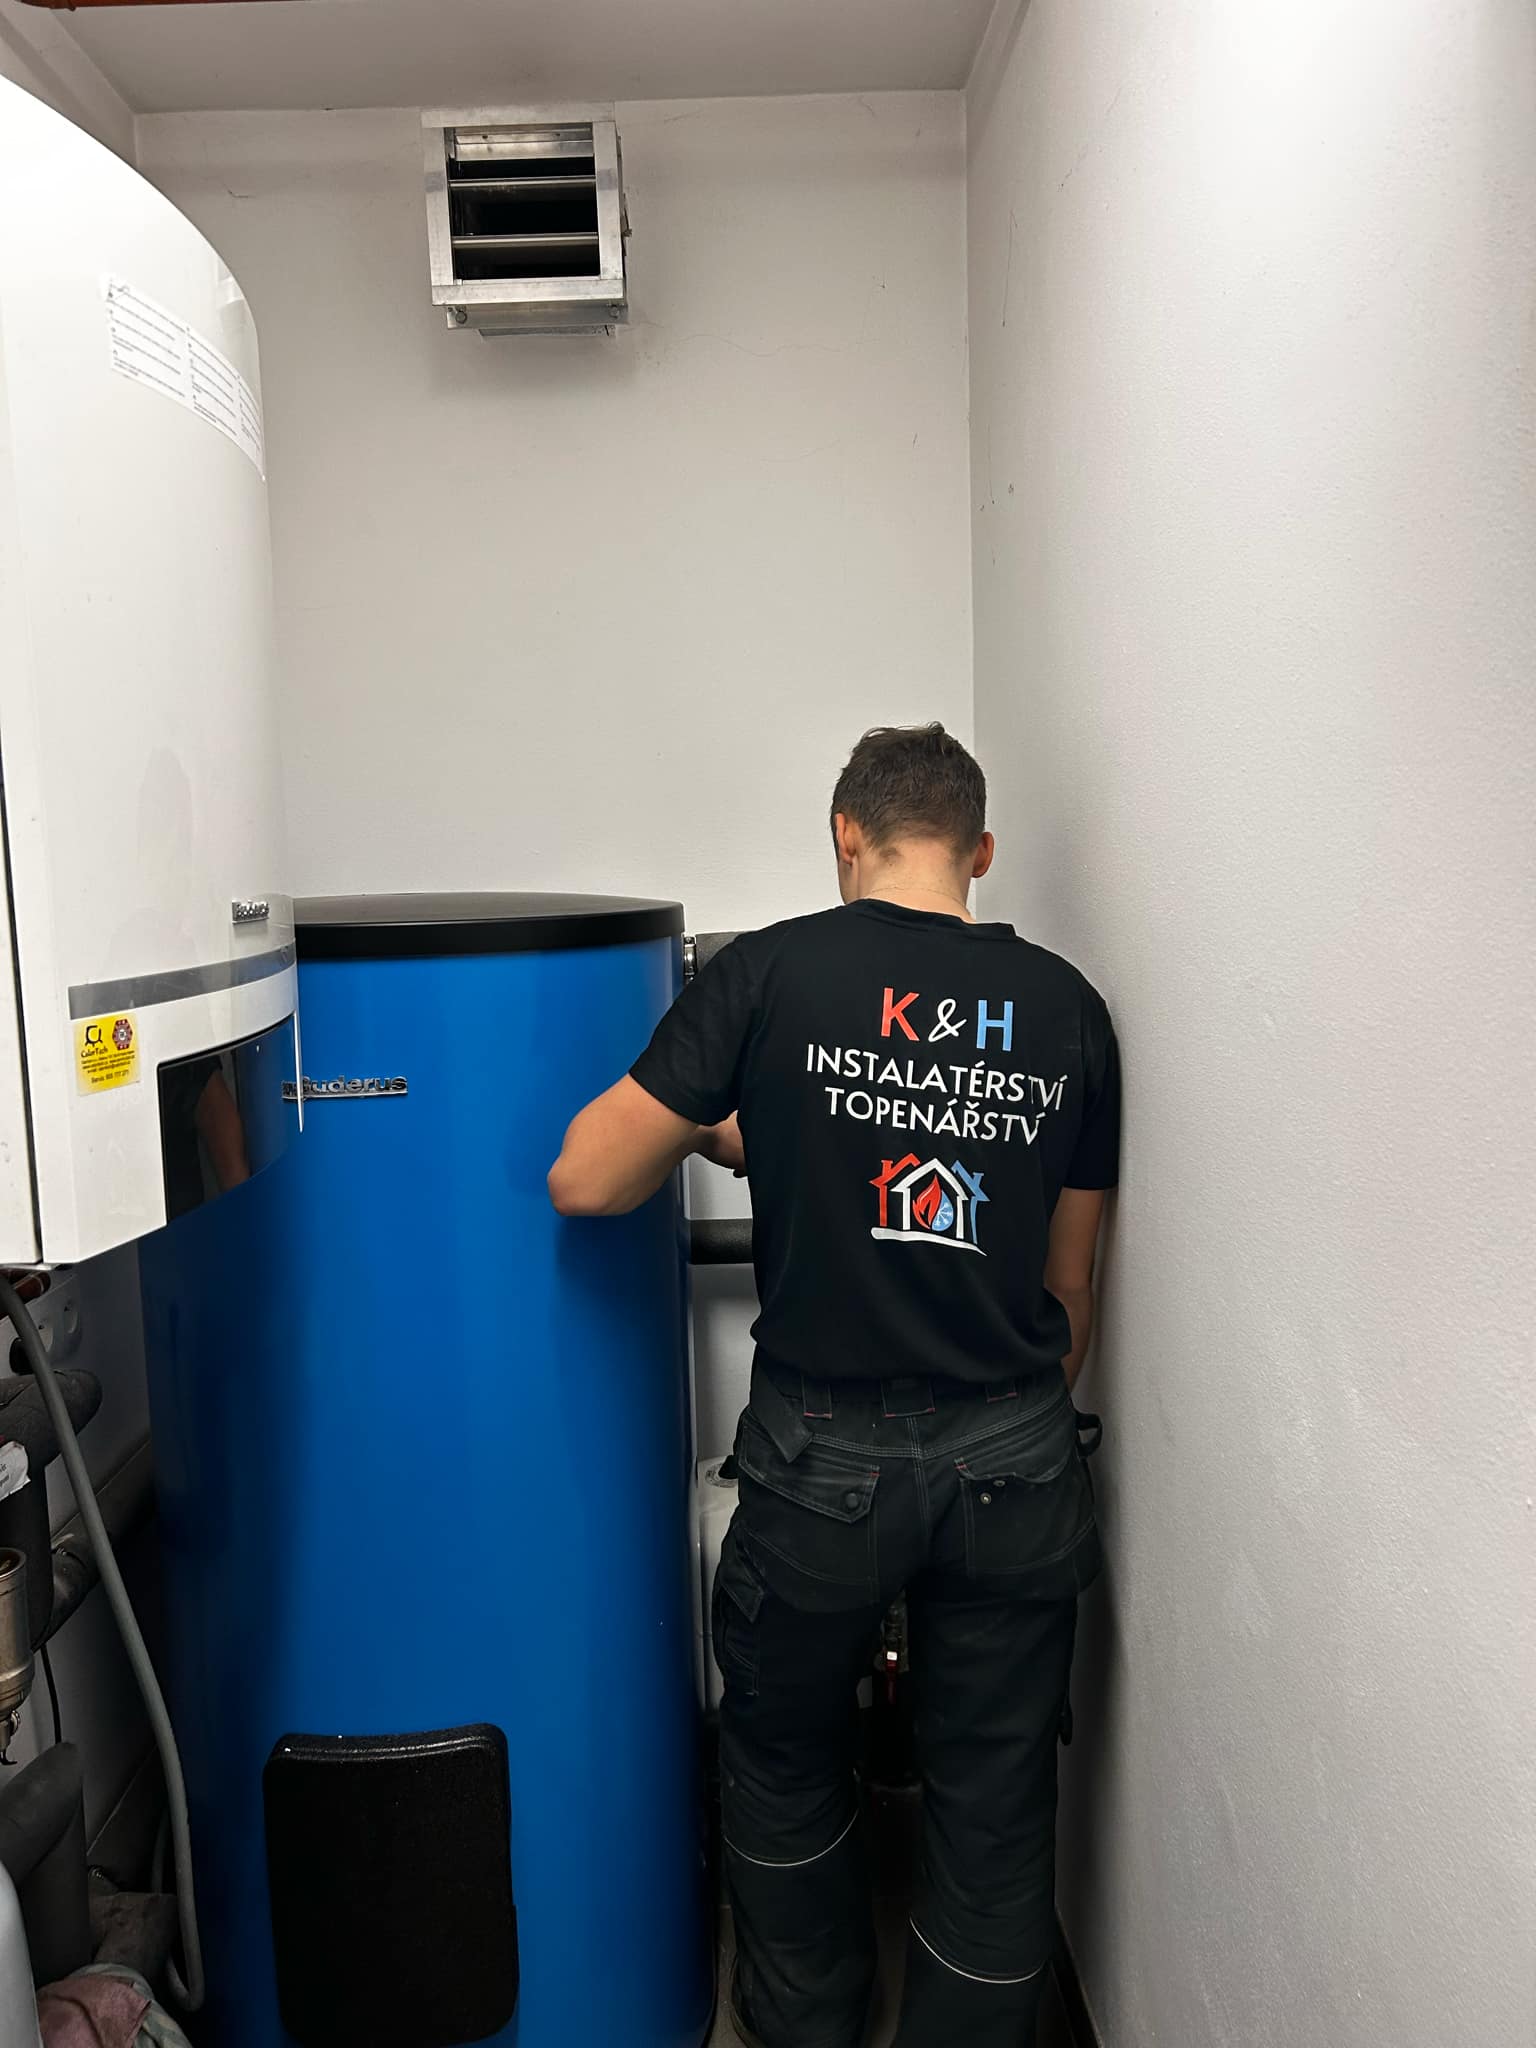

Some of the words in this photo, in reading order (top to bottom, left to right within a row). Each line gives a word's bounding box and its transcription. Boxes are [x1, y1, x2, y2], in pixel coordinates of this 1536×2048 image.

[881, 987, 920, 1042] K
[928, 998, 967, 1043] &
[976, 999, 1014, 1052] H
[806, 1043, 1068, 1111] INSTALATÉRSTVÍ
